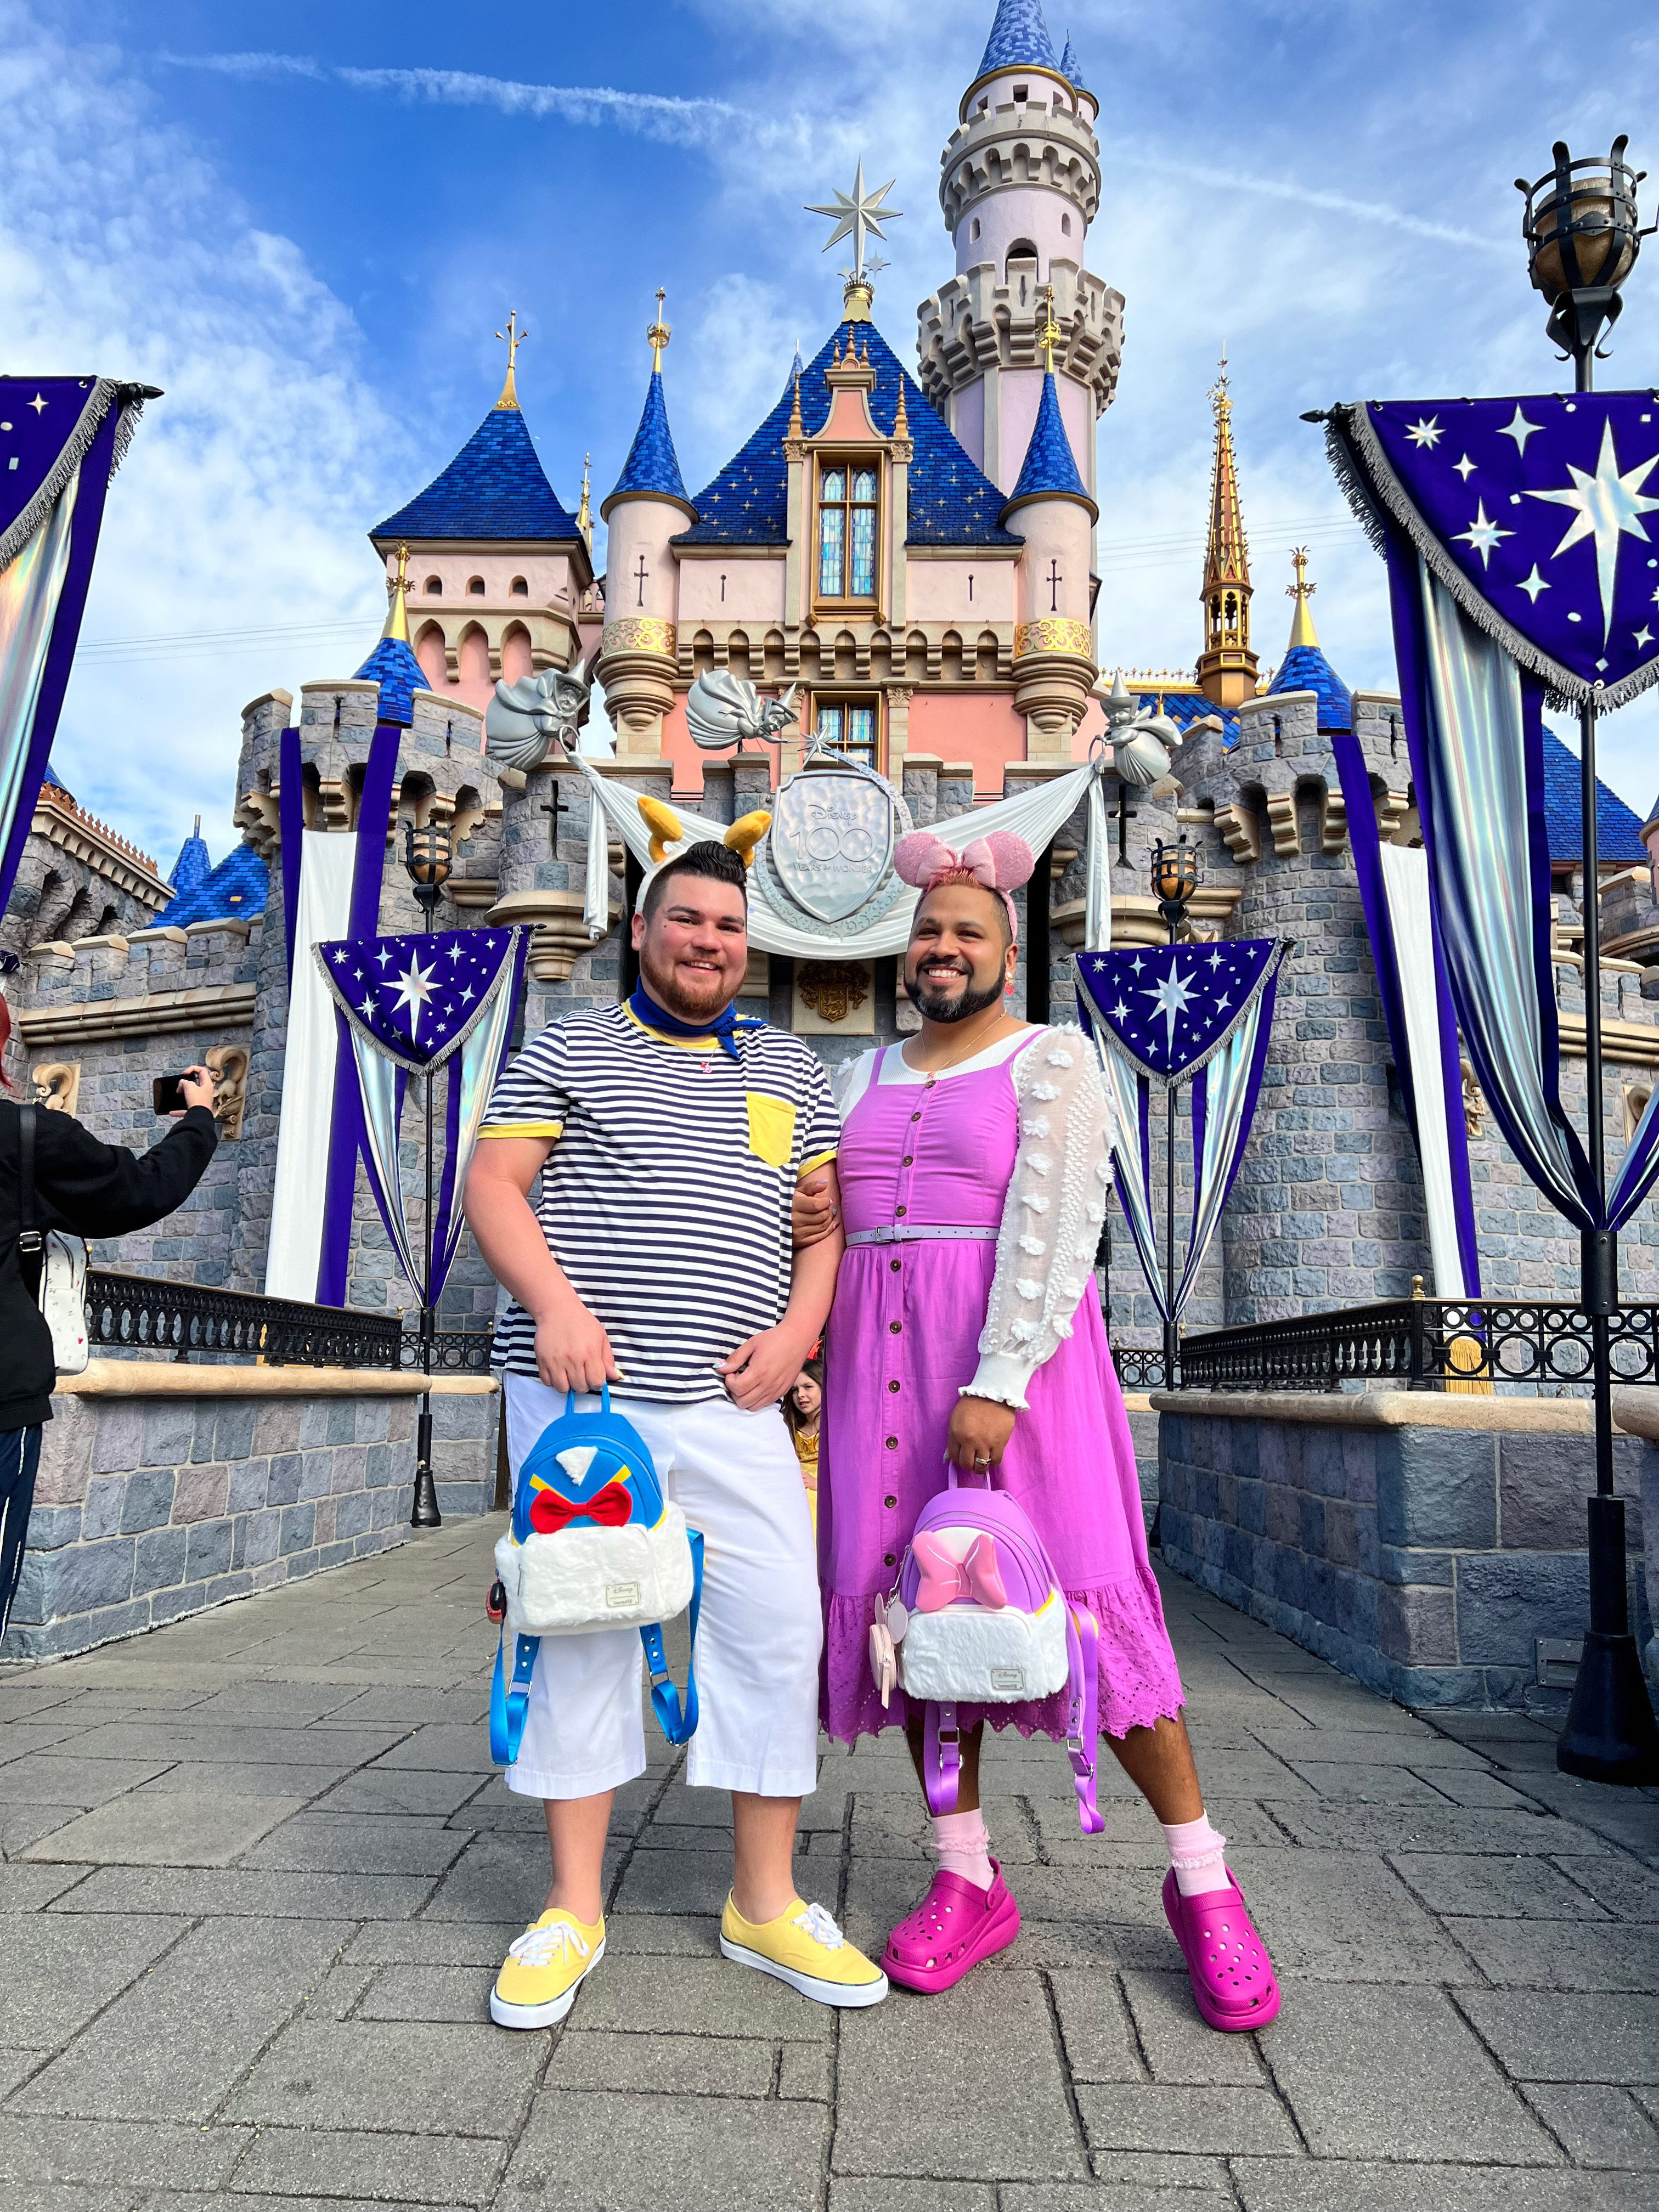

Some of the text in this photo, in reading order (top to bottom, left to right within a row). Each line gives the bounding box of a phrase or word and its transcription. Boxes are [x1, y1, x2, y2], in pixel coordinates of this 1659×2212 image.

[808, 804, 857, 826] Disney
[789, 827, 876, 862] 100
[793, 863, 821, 872] YEARS
[833, 865, 873, 873] WONDER
